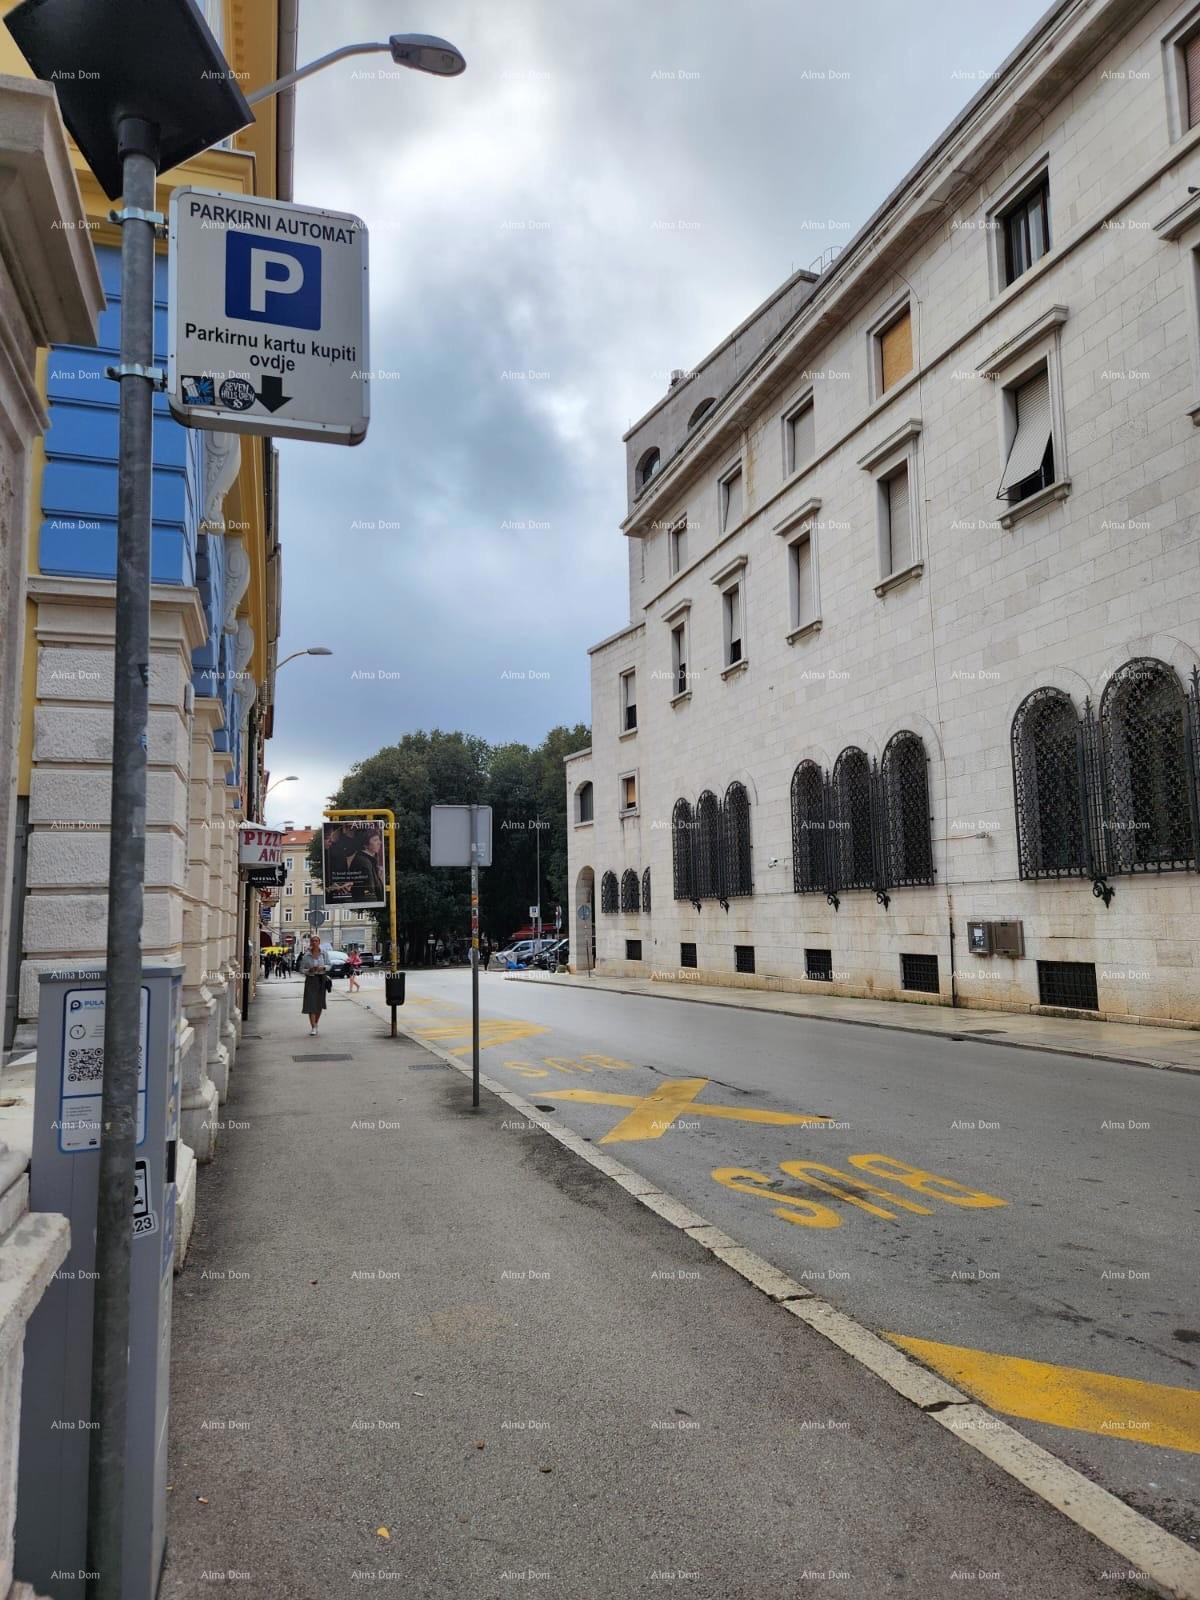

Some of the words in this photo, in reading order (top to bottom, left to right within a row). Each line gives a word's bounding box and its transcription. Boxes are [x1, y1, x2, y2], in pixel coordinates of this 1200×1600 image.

[190, 202, 271, 230] PARKIRNI
[275, 217, 356, 244] AUTOMAT
[250, 247, 305, 312] P
[185, 322, 258, 348] Parkirnu
[264, 334, 306, 354] kartu
[311, 341, 356, 362] kupiti
[250, 354, 295, 373] ovdje
[224, 381, 250, 393] SEVEN
[244, 831, 281, 847] PIZZ
[258, 848, 281, 862] ANT
[711, 1153, 1010, 1229] BUS
[133, 1217, 152, 1232] 23
